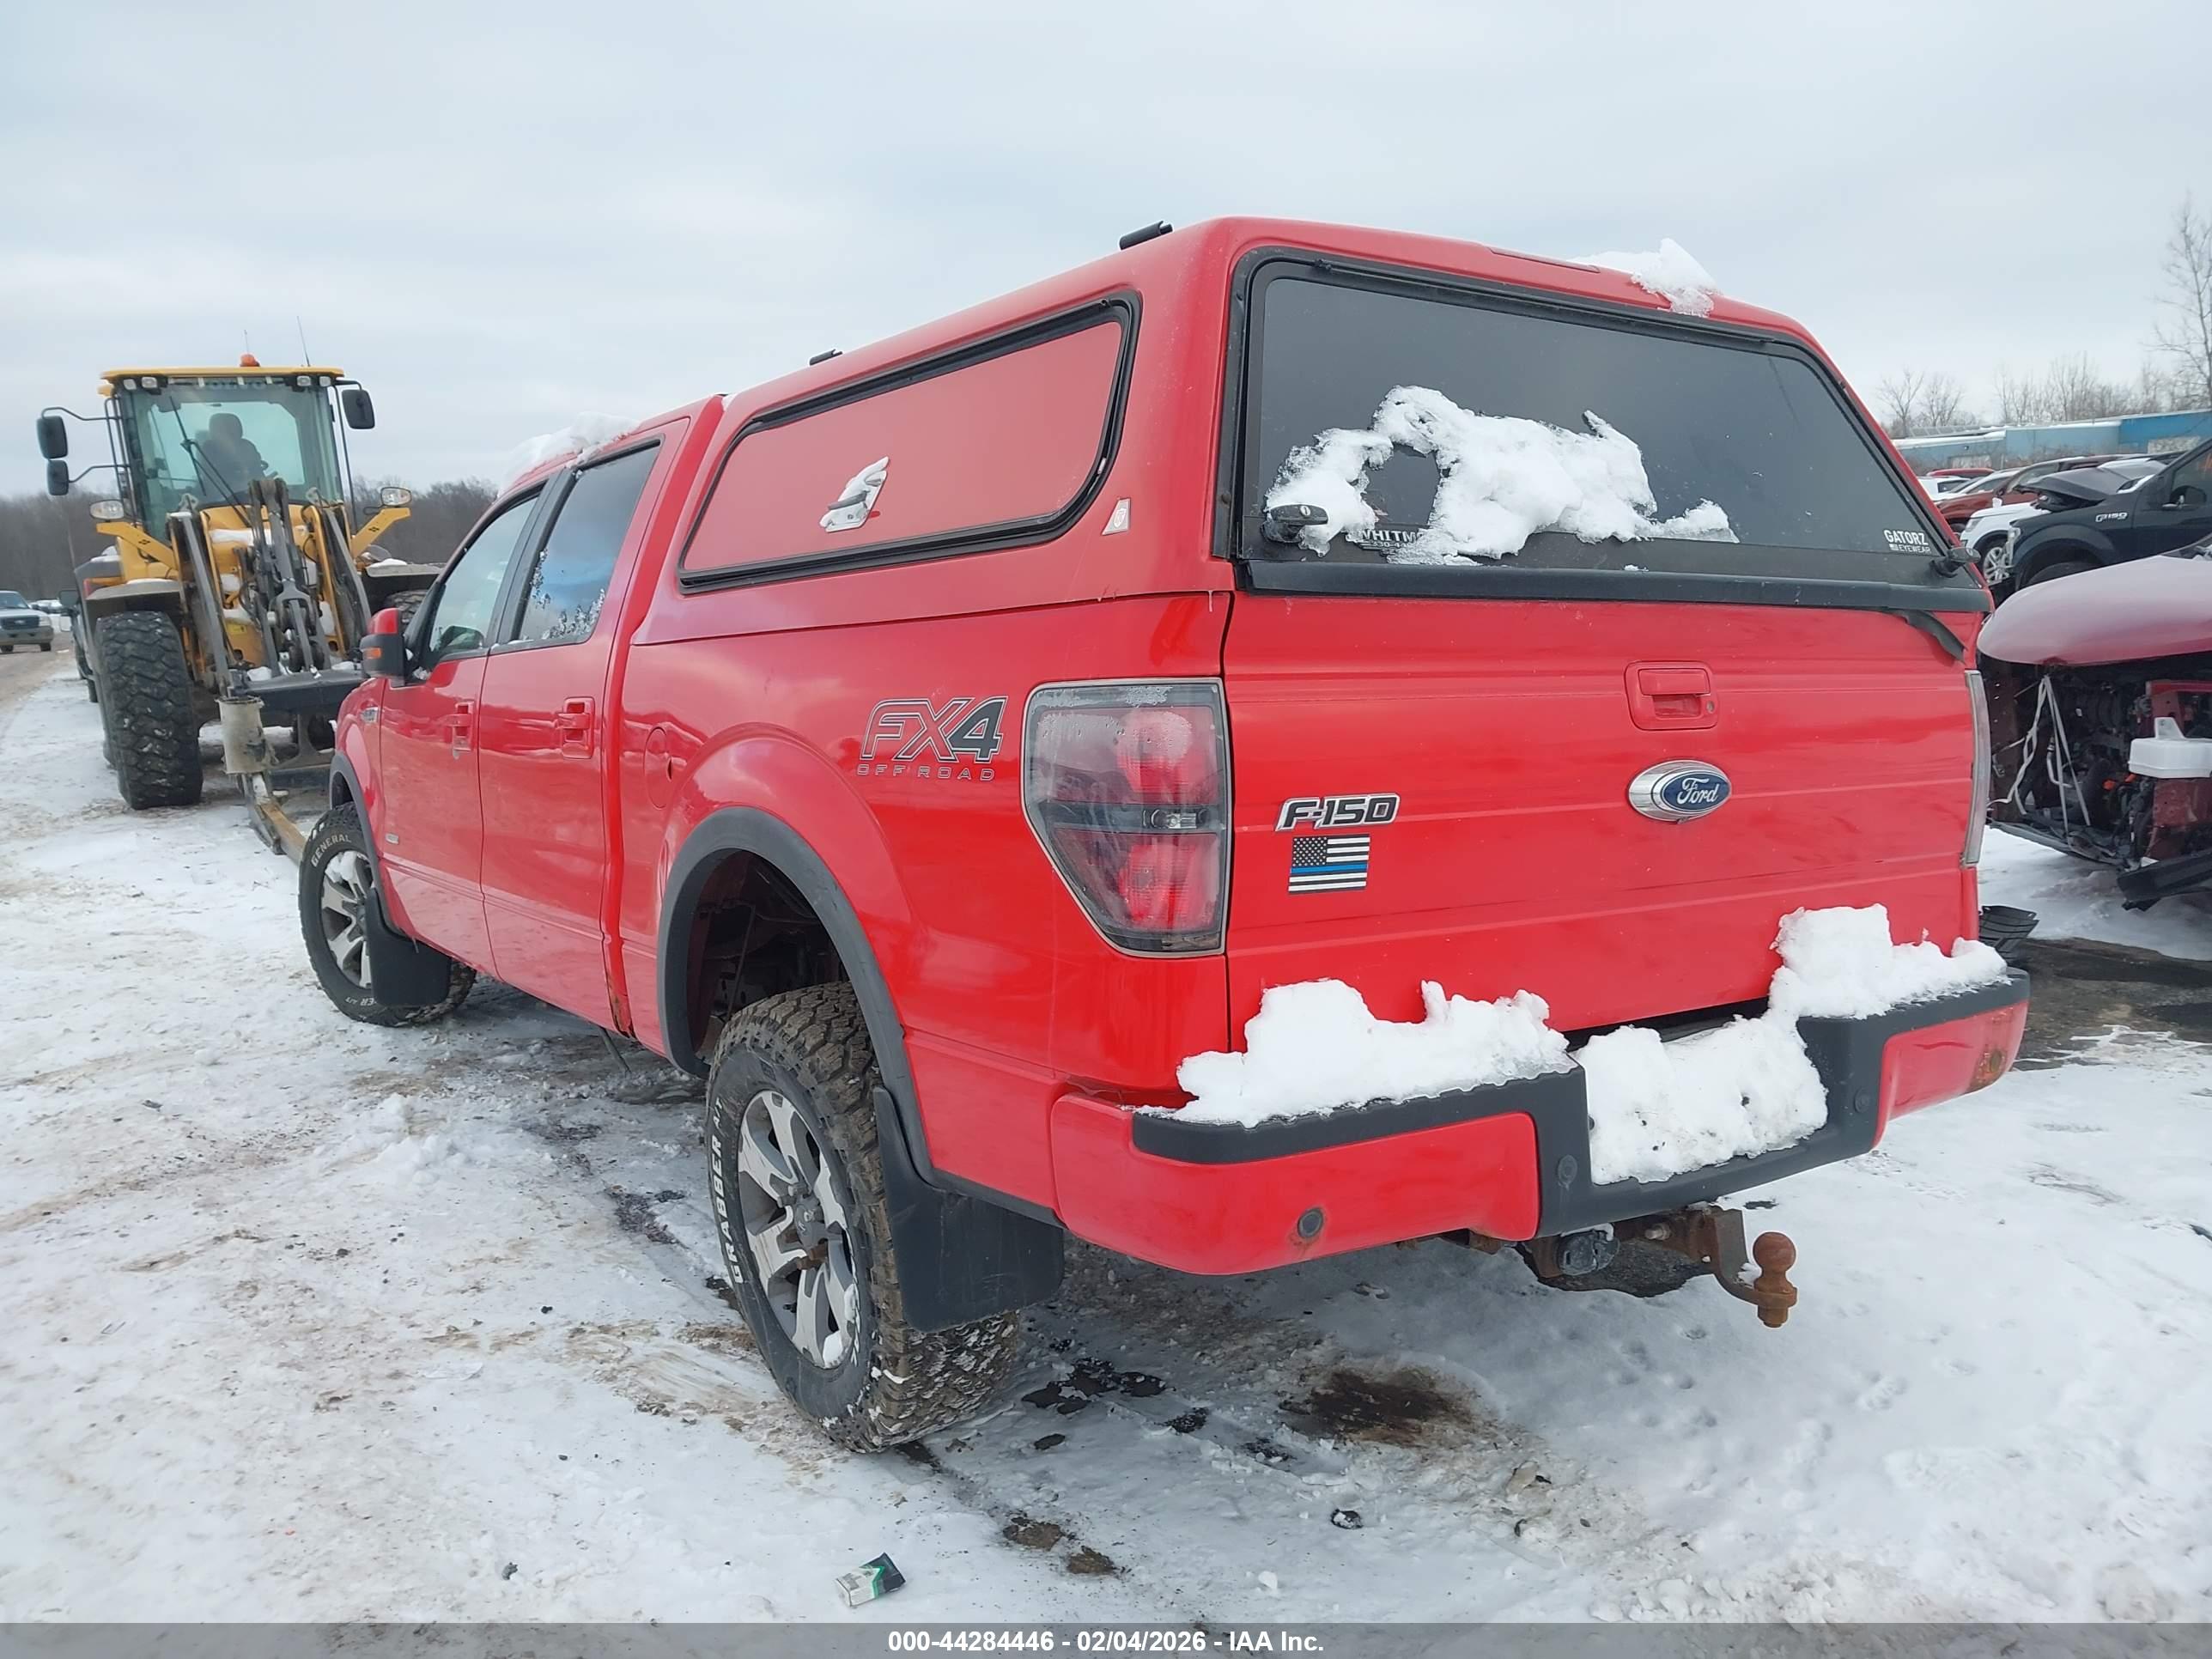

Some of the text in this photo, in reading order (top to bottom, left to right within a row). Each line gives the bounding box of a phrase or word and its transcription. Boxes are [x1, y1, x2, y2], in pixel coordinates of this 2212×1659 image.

[1883, 529, 1929, 545] GATORZ
[860, 696, 1008, 763] FX4
[857, 764, 995, 781] OFF ROAD
[1677, 777, 1719, 805] Ford
[1275, 793, 1400, 831] F-150
[311, 834, 352, 867] GENERAL
[711, 1134, 744, 1284] GRABBER
